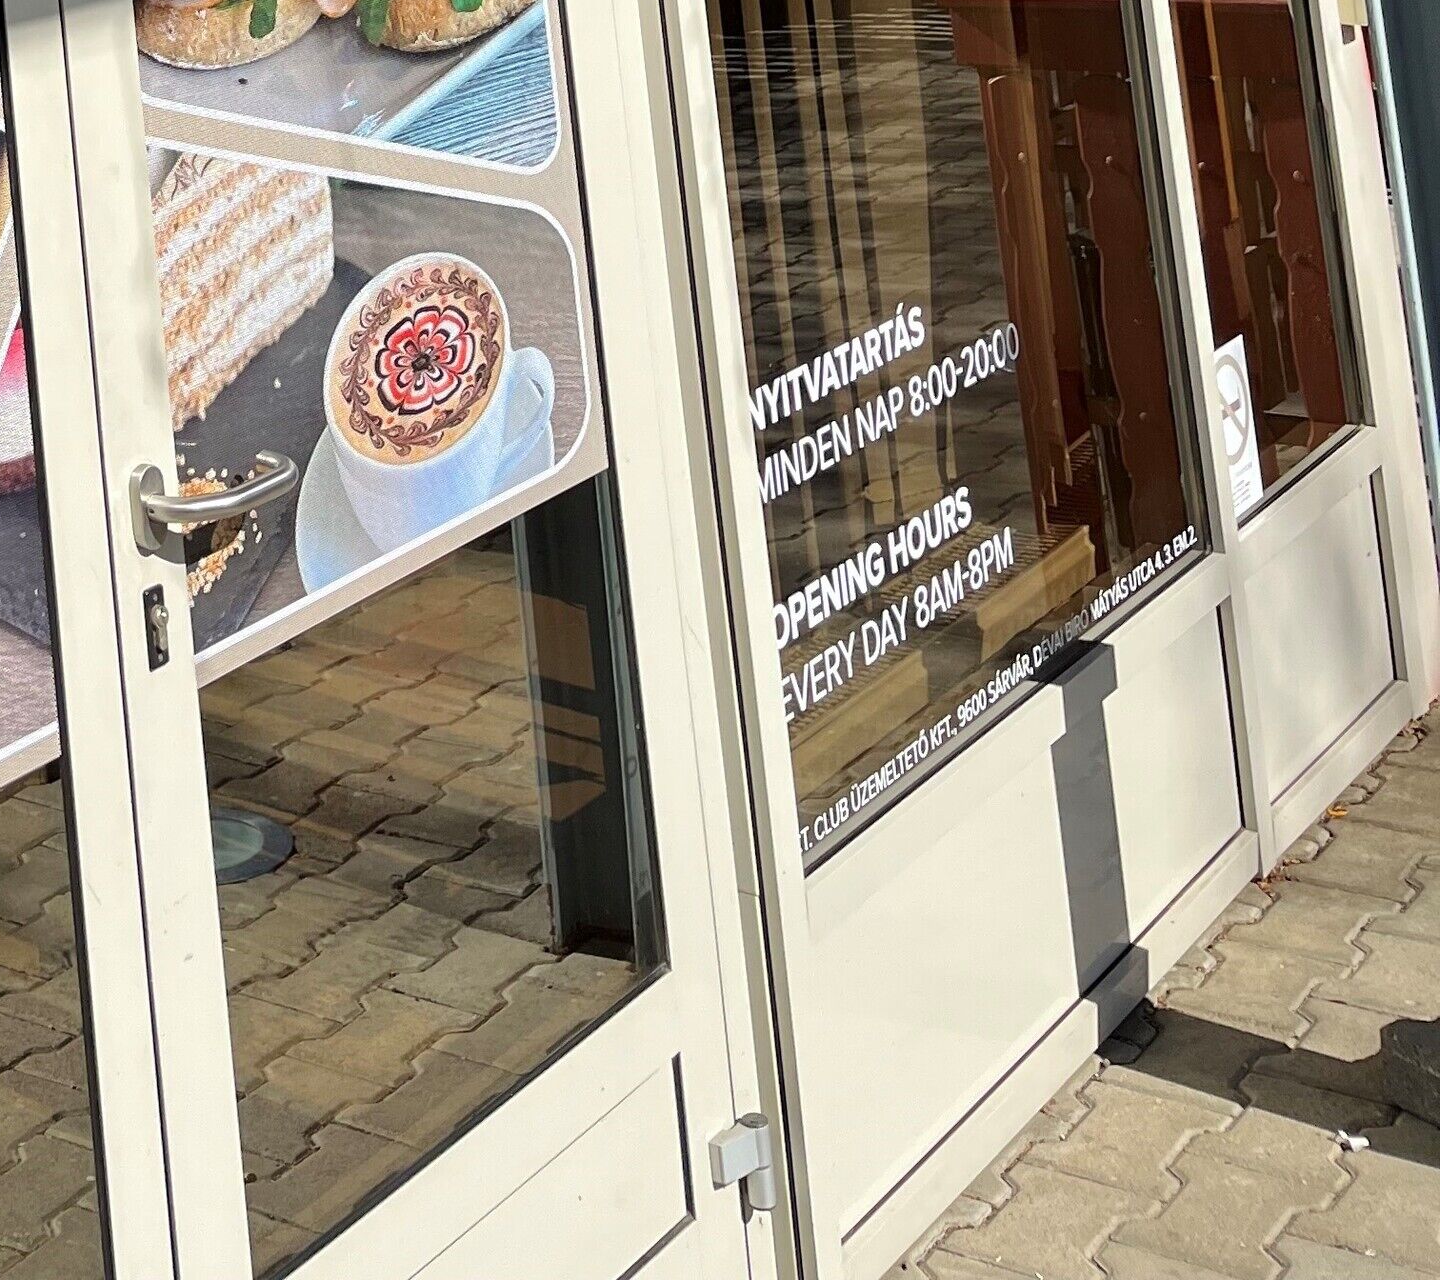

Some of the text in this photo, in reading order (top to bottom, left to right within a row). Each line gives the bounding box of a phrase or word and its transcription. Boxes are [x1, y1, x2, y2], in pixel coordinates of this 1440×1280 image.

[749, 302, 925, 431] NYITVATARTÁS
[855, 386, 904, 448] NAP
[909, 323, 1020, 417] 8:00-20:00
[773, 488, 972, 651] OPENING HOURS
[781, 526, 1014, 724] EVERY DAY 8AM-8PM
[799, 826, 813, 852] T.
[814, 797, 849, 841] CLUB
[956, 692, 988, 727] 9600
[987, 652, 1034, 700] SÁRVÁR,
[1129, 557, 1156, 592] UTCA
